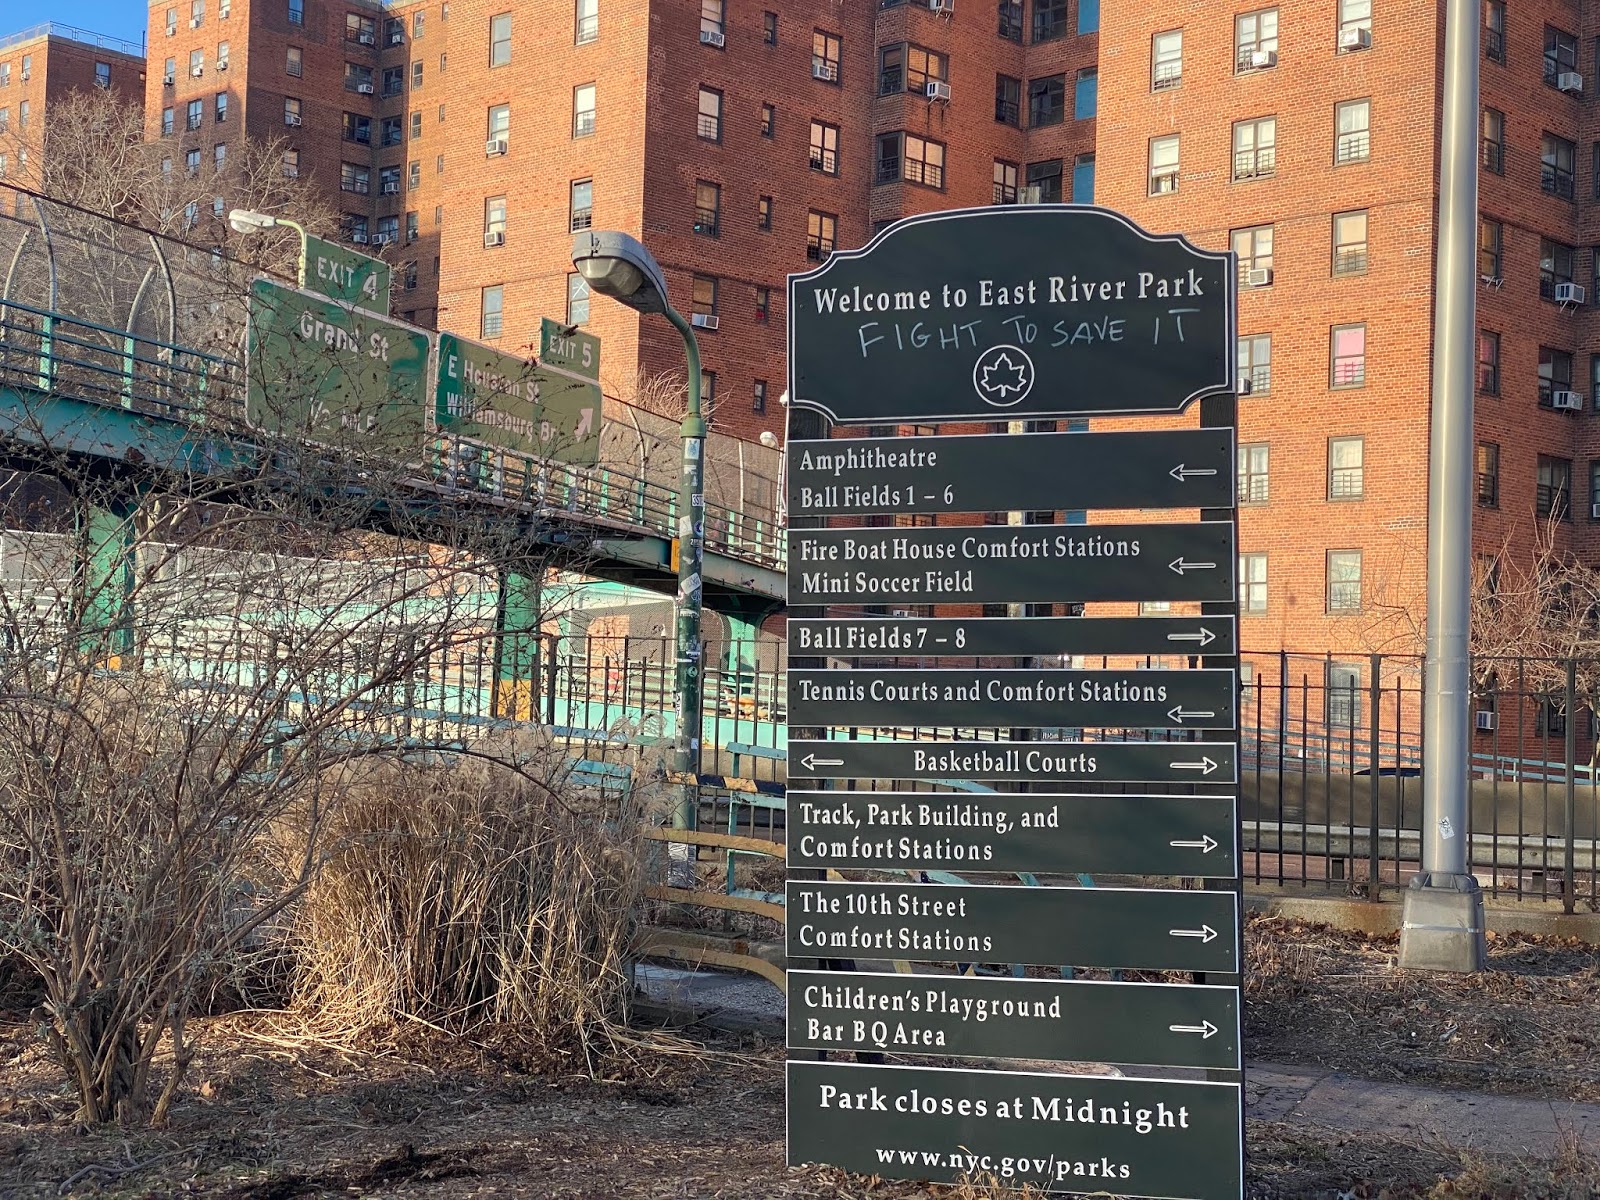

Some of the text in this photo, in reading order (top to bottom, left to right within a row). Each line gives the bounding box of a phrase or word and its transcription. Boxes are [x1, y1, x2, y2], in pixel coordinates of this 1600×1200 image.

[317, 256, 378, 301] EXIT 4
[814, 269, 1203, 313] Welcome to East River Park
[300, 310, 389, 362] Grand St
[859, 308, 1201, 358] FIGHT TO SAVE IT
[550, 335, 592, 368] EXIT 5
[448, 354, 458, 378] E
[526, 381, 540, 404] St
[800, 447, 936, 476] Amphitheatre
[801, 486, 838, 507] Ball
[844, 485, 900, 506] Fields
[906, 486, 915, 505] 1
[944, 485, 953, 504] 6
[801, 535, 1139, 560] Fire Boat House Comfort Stations
[802, 570, 973, 593] Mini Soccer Field
[799, 626, 841, 648] Ball
[847, 626, 911, 648] Fields
[917, 628, 927, 648] 7
[956, 628, 965, 648] 8
[799, 680, 1166, 701] Tennis Courts and Comfort Stations
[914, 750, 1096, 772] Basketball Courts
[800, 803, 1058, 834] Track, Park Building, and
[801, 835, 992, 860] Comfort Stations
[800, 891, 965, 917] The 10th Street
[800, 925, 991, 951] Comfort Stations
[926, 991, 1061, 1021] Playground
[808, 1018, 843, 1041] Bar
[893, 1022, 945, 1046] Area
[820, 1085, 1188, 1133] Park closes at Midnight
[876, 1148, 1130, 1181] www.nyc.gov/parks
